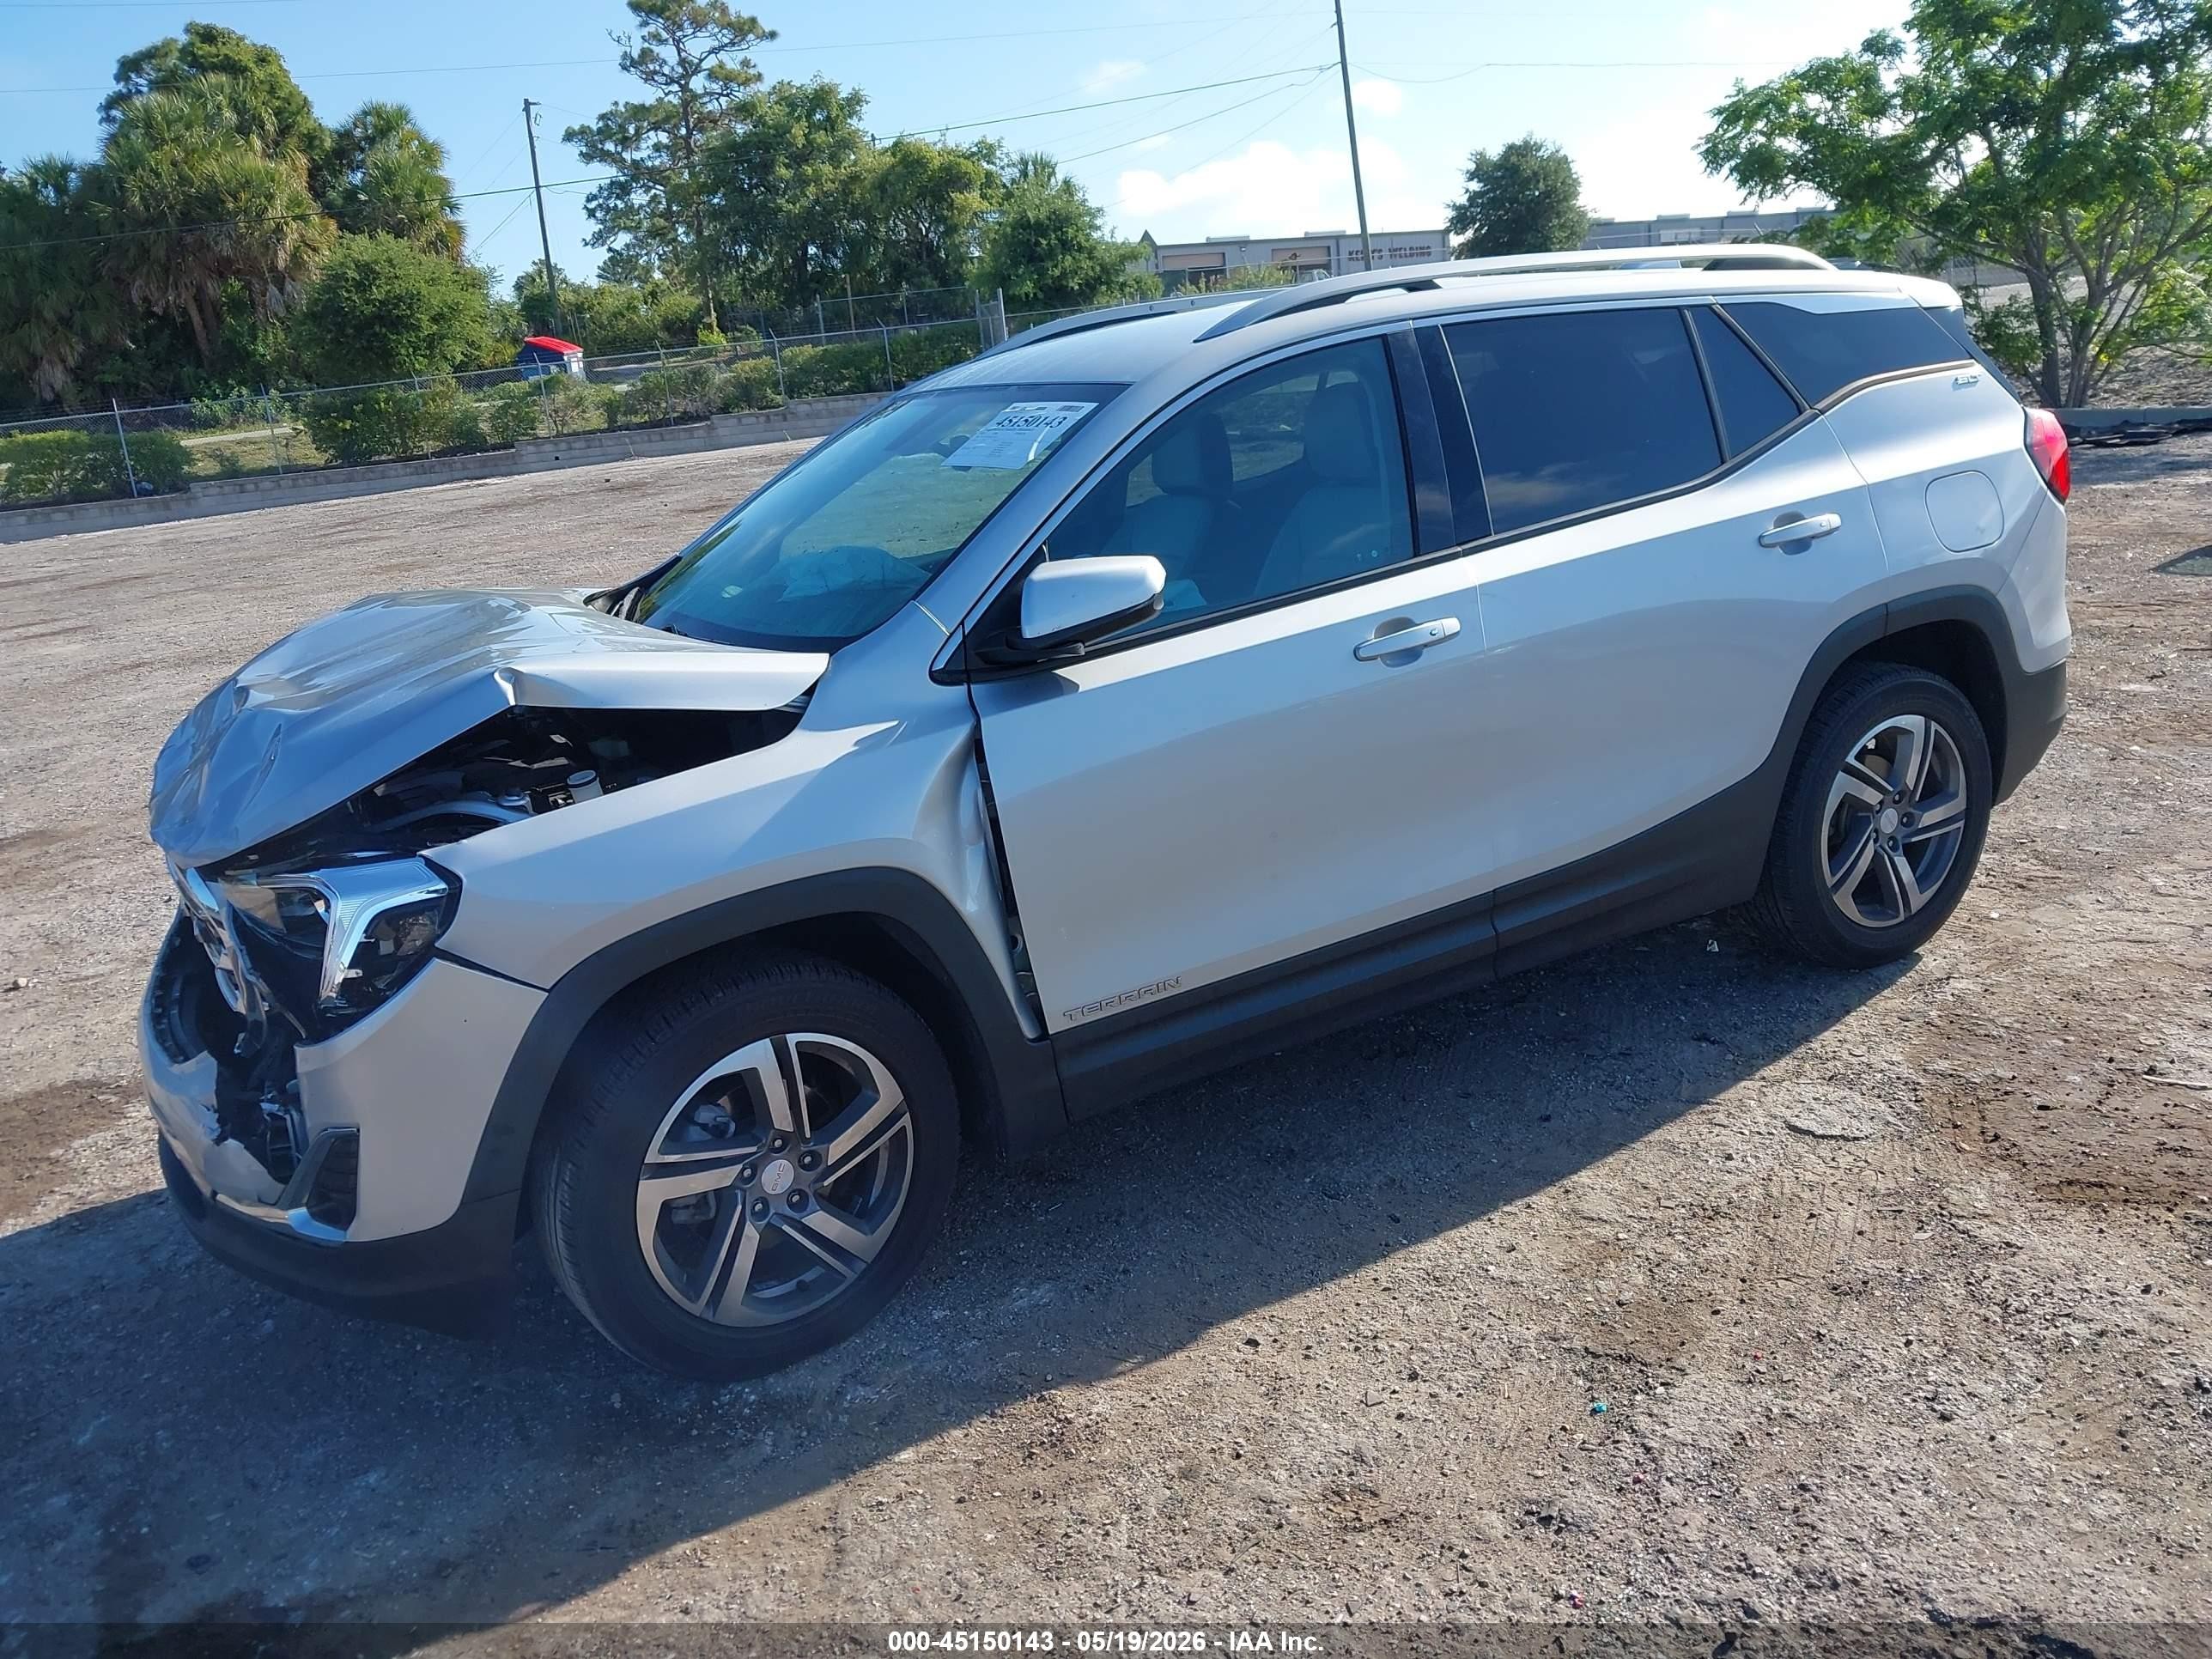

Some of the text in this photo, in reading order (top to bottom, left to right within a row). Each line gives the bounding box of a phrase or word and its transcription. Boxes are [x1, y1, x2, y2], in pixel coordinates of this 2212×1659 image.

[1388, 245, 1432, 259] WELDING
[995, 415, 1067, 428] 45150143
[1063, 975, 1182, 1021] TERRAIN
[771, 1163, 786, 1192] GMC
